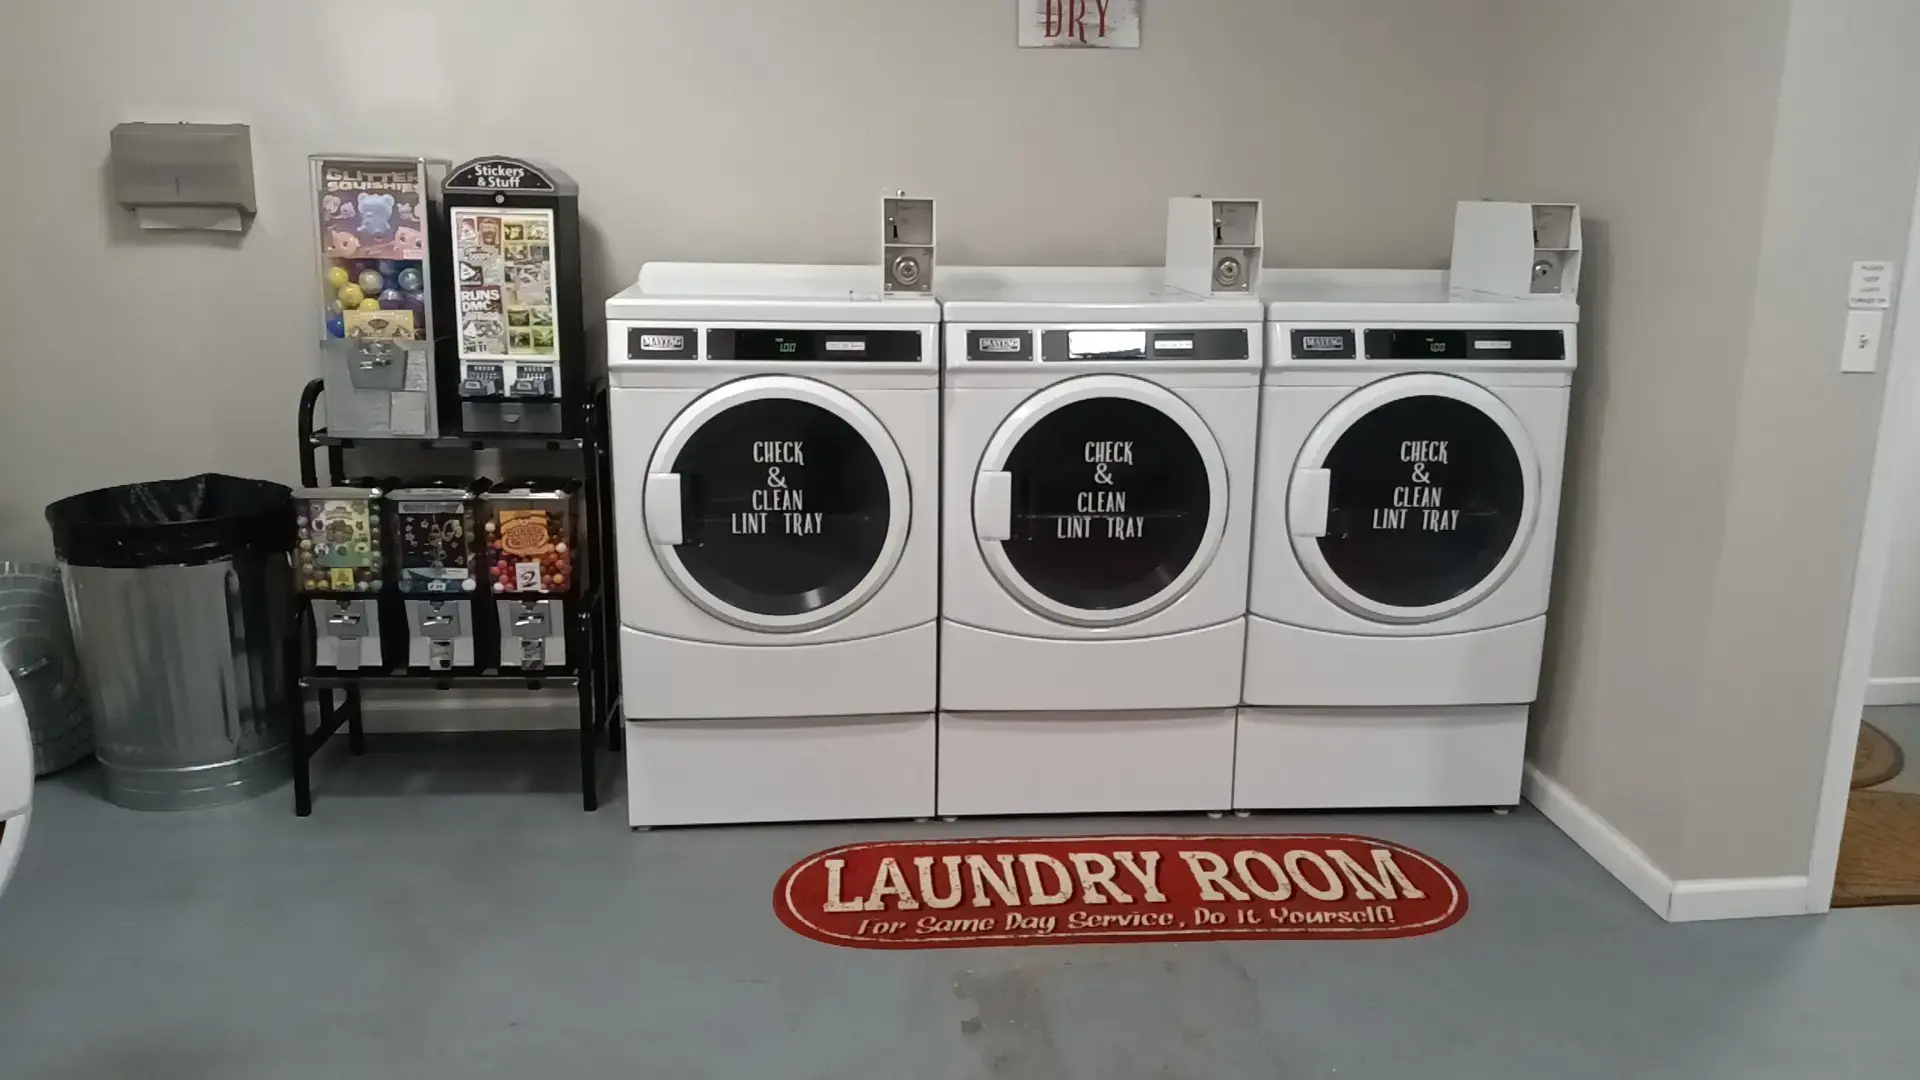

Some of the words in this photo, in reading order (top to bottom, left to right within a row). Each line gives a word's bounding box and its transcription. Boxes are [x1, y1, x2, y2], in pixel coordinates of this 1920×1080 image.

[1044, 0, 1109, 44] DRY
[474, 164, 525, 177] Stickers
[477, 176, 487, 187] &
[488, 176, 520, 188] Stuff
[461, 289, 500, 301] RUNS
[461, 300, 491, 312] DMC
[642, 335, 683, 348] MAYTAG
[753, 441, 804, 466] CHECK
[1084, 441, 1134, 465] CHECK
[1400, 440, 1449, 464] CHECK
[767, 466, 788, 488] &
[1094, 462, 1114, 485] &
[1411, 462, 1431, 484] &
[752, 489, 803, 511] CLEAN
[1077, 491, 1126, 513] CLEAN
[1393, 486, 1442, 508] CLEAN
[731, 512, 768, 534] LINT
[783, 512, 823, 536] TRAY
[1057, 515, 1092, 539] LINT
[1106, 516, 1144, 540] TRAY
[1372, 508, 1408, 530] LINT
[1422, 509, 1460, 532] TRAY
[823, 850, 1167, 913] LAUNDRY
[1179, 849, 1426, 901] ROOM
[858, 918, 907, 934] For
[916, 916, 995, 934] Same
[1005, 912, 1056, 934] Day
[1194, 907, 1226, 925] Do
[1237, 908, 1262, 925] It
[1269, 905, 1396, 925] Yourself!
